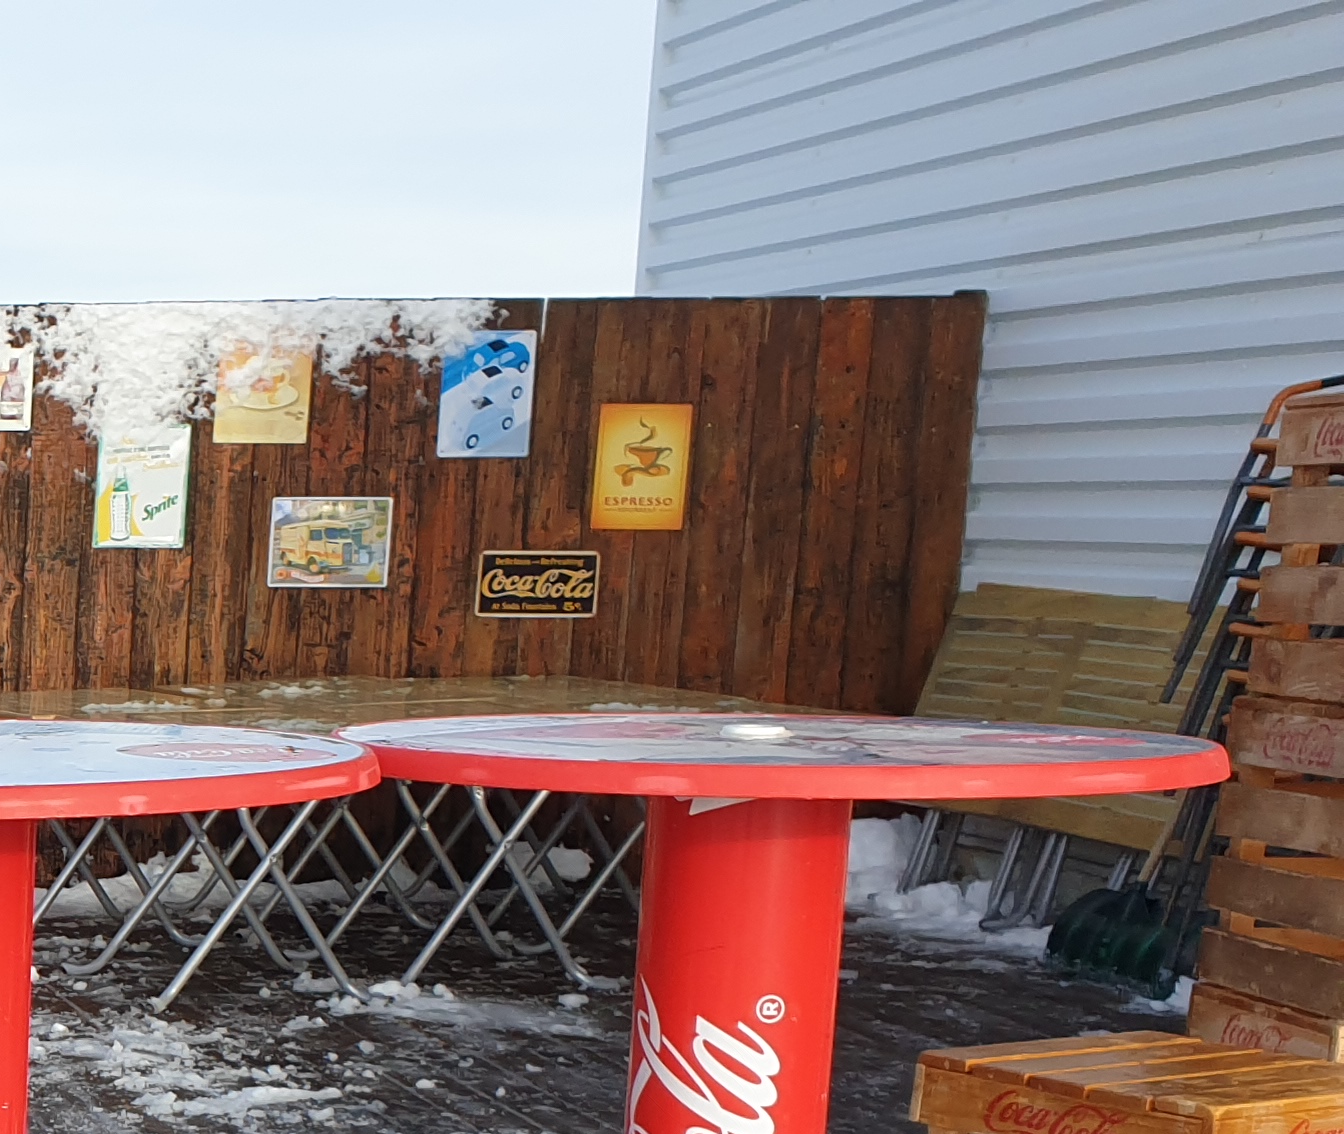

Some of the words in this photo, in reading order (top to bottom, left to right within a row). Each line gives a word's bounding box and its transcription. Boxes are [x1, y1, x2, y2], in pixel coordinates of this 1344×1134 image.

[141, 495, 179, 521] Sprite
[604, 496, 673, 506] ESPRESSO
[481, 568, 594, 599] Coca-Cola
